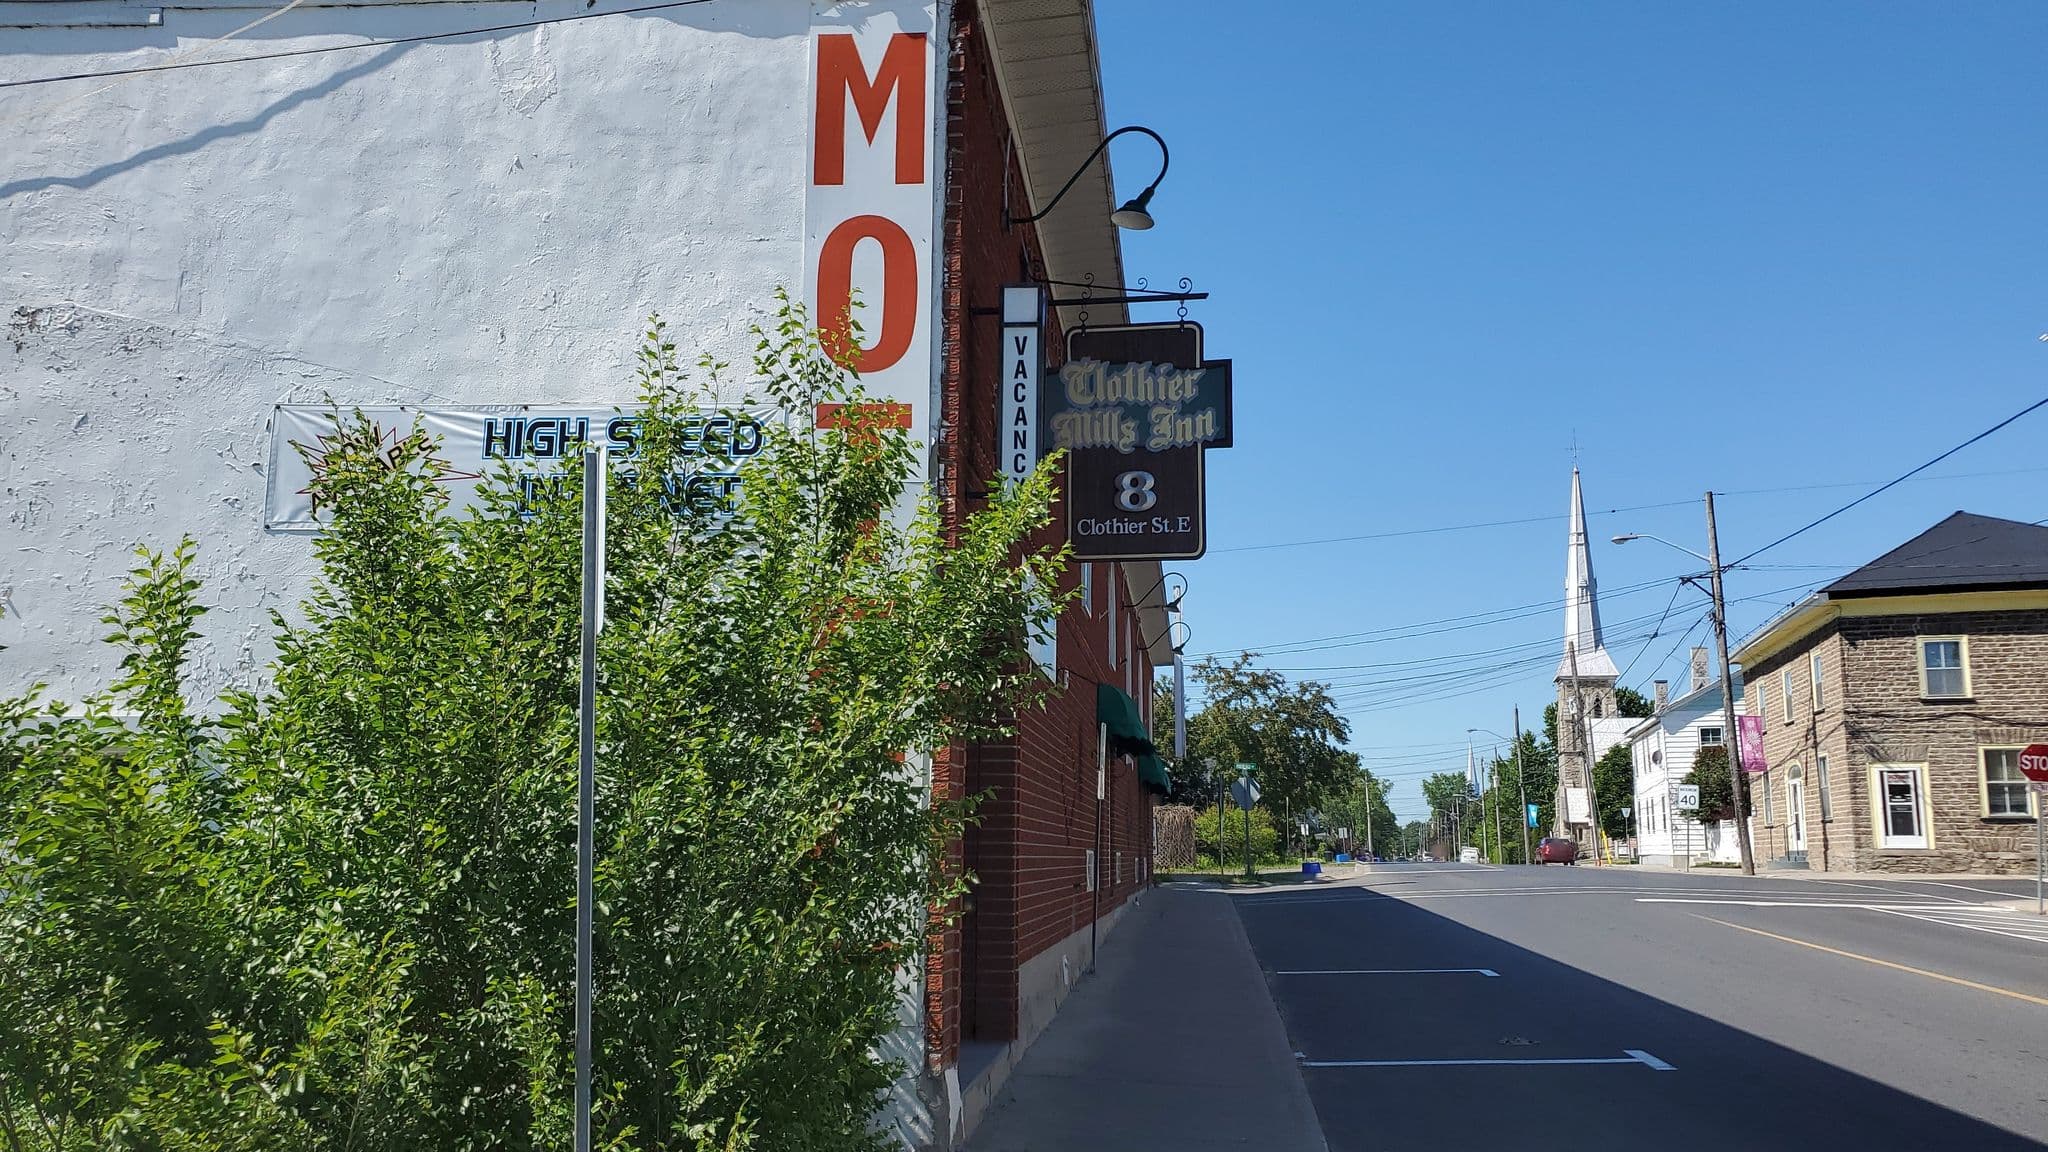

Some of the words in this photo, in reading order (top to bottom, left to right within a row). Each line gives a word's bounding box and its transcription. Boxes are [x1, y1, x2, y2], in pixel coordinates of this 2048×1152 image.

[1062, 360, 1205, 405] Clothier
[482, 417, 589, 460] HIGH
[605, 417, 766, 458] SEED
[1053, 409, 1138, 452] Mills
[1149, 406, 1219, 450] Inn
[1114, 470, 1157, 512] 8
[1077, 518, 1147, 536] Clothier
[2021, 754, 2048, 770] STO
[1680, 795, 1697, 806] 40
